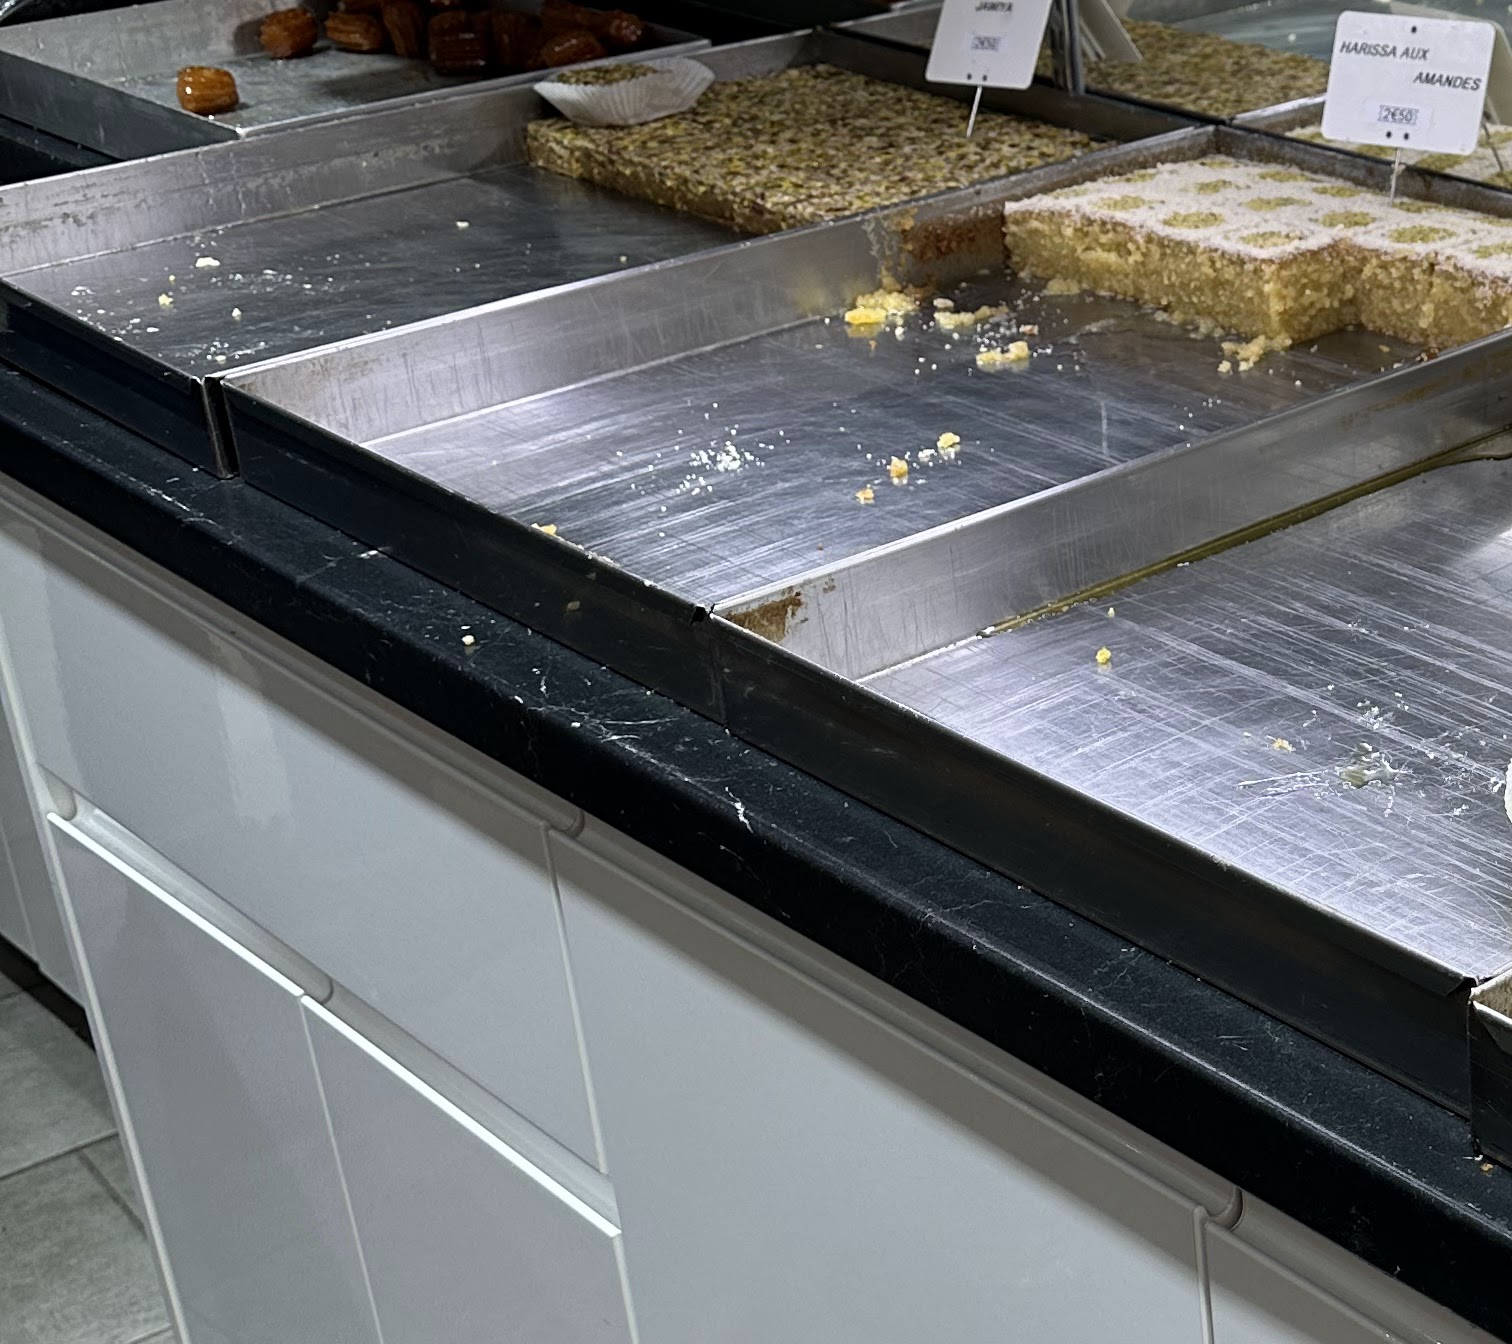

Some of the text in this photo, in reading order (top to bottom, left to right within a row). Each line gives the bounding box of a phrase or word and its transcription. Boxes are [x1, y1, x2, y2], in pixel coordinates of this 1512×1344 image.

[1340, 41, 1430, 61] HARISSA AUX
[1413, 72, 1482, 91] AMANDES
[1382, 107, 1414, 123] 2€50
